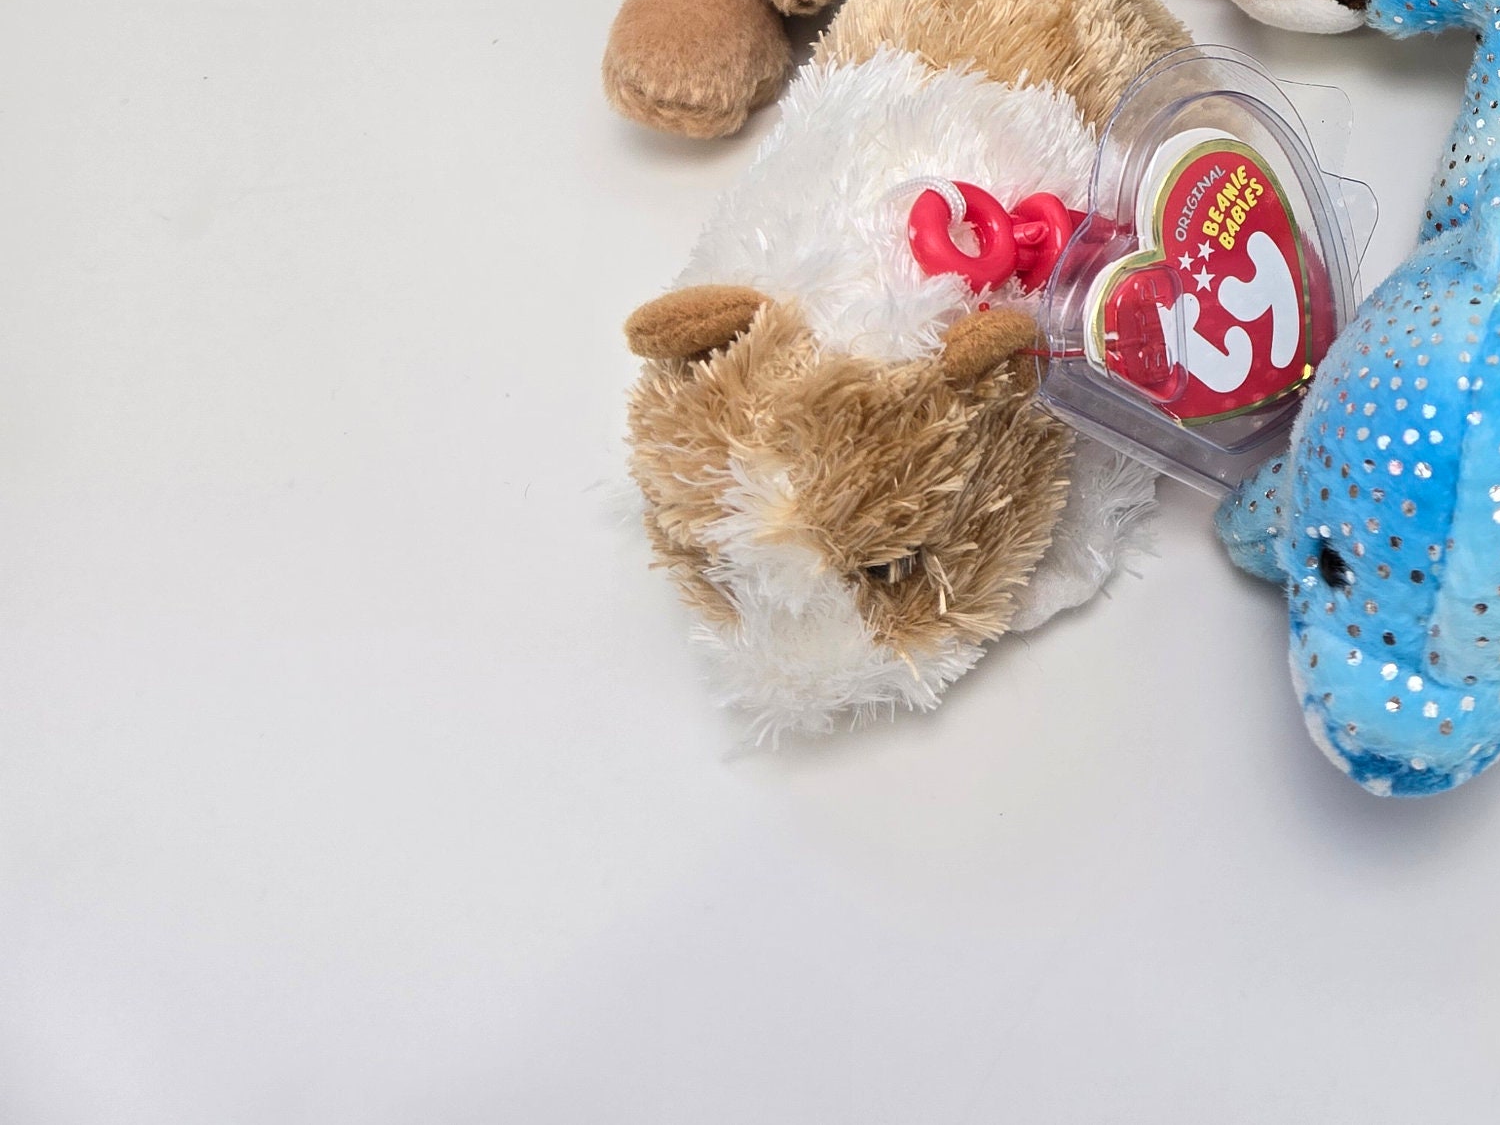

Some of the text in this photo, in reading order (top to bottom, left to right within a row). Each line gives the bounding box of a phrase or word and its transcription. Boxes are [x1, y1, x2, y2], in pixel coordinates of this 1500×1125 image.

[1174, 163, 1227, 243] ORIGINAL
[1201, 164, 1248, 238] BEANIE
[1218, 176, 1265, 251] BABIES
